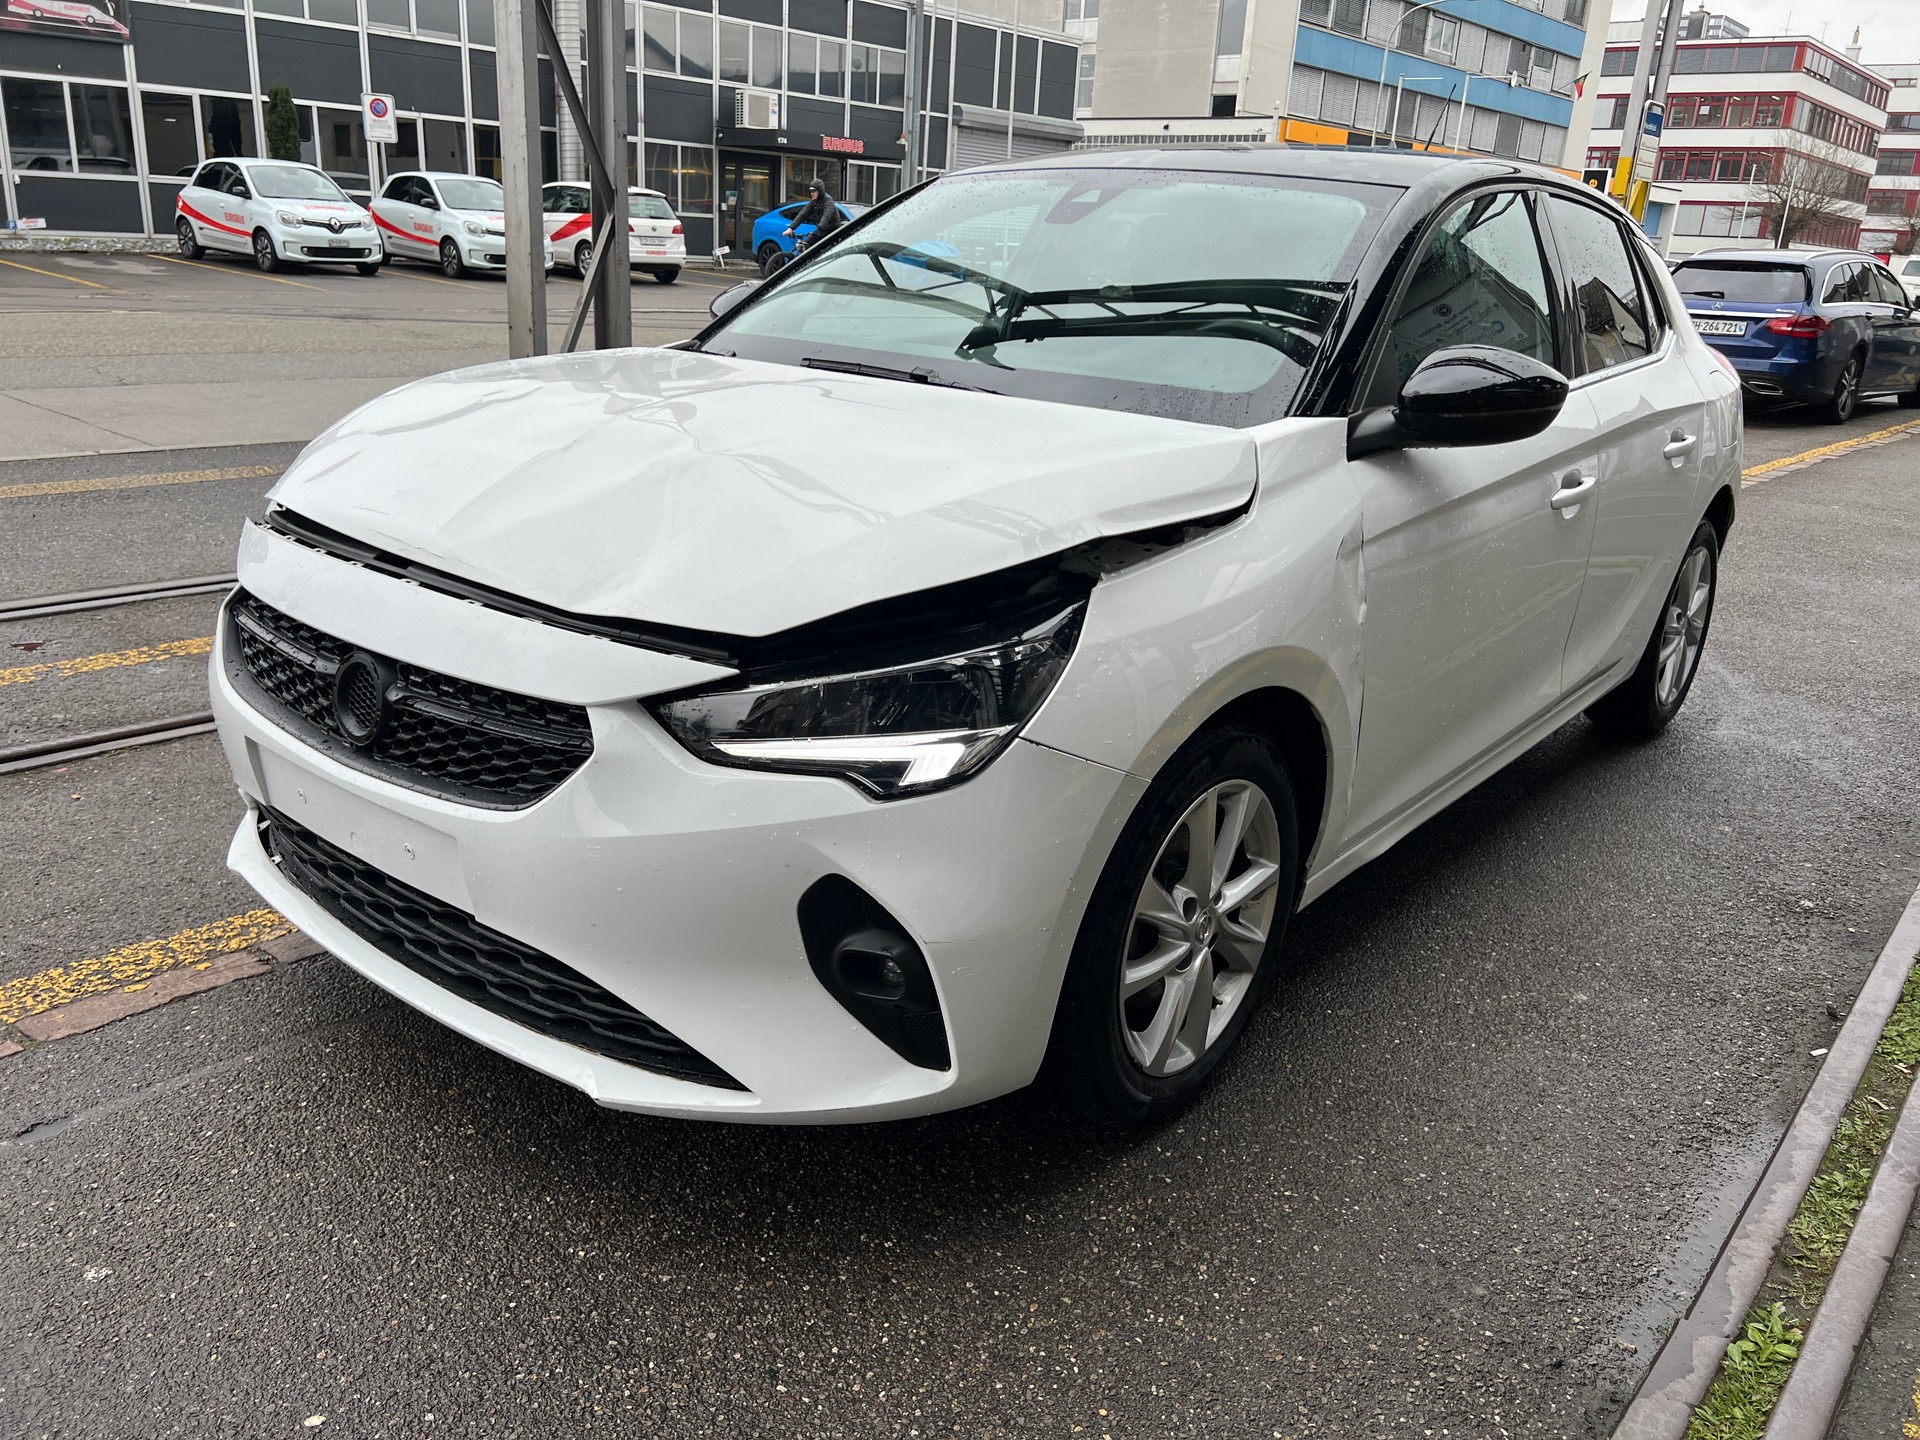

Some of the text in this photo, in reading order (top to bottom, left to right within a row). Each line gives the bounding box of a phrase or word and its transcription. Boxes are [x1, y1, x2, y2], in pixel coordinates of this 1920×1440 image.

[822, 136, 864, 154] EUROBUS
[224, 212, 245, 225] EUROBUS
[413, 222, 434, 234] EUROBUS
[1720, 322, 1738, 333] 721
